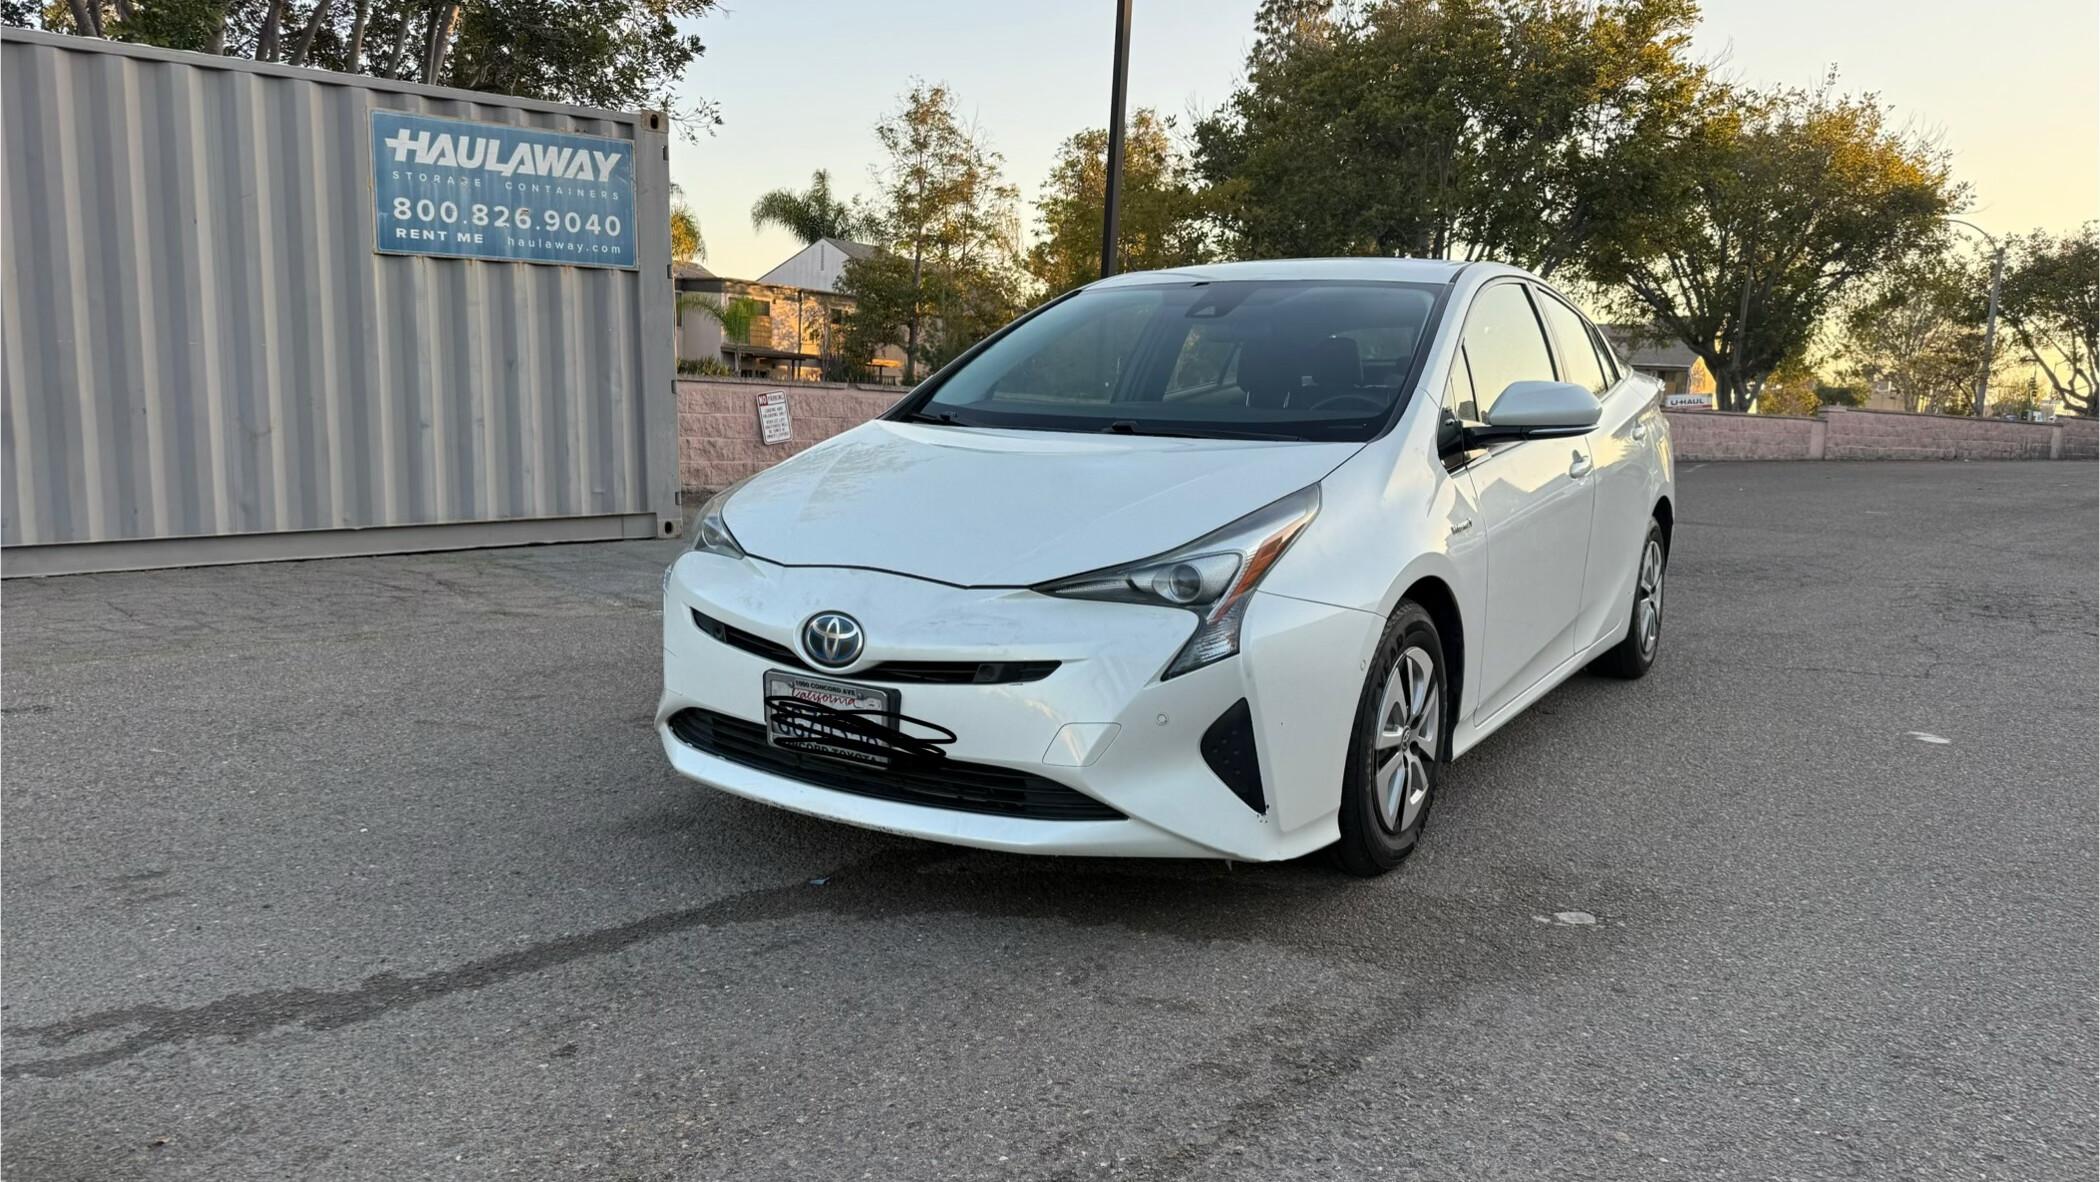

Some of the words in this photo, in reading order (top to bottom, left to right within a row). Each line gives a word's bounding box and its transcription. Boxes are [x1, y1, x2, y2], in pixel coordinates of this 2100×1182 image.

[385, 128, 622, 182] HAULAWAY
[504, 181, 619, 200] CONTAINERS
[393, 197, 622, 237] 800.826.9040
[396, 227, 448, 242] RENT
[457, 232, 484, 244] ME
[507, 236, 621, 255] haulaway.com
[1670, 398, 1705, 406] U-HAUL
[810, 682, 842, 693] CONCORD
